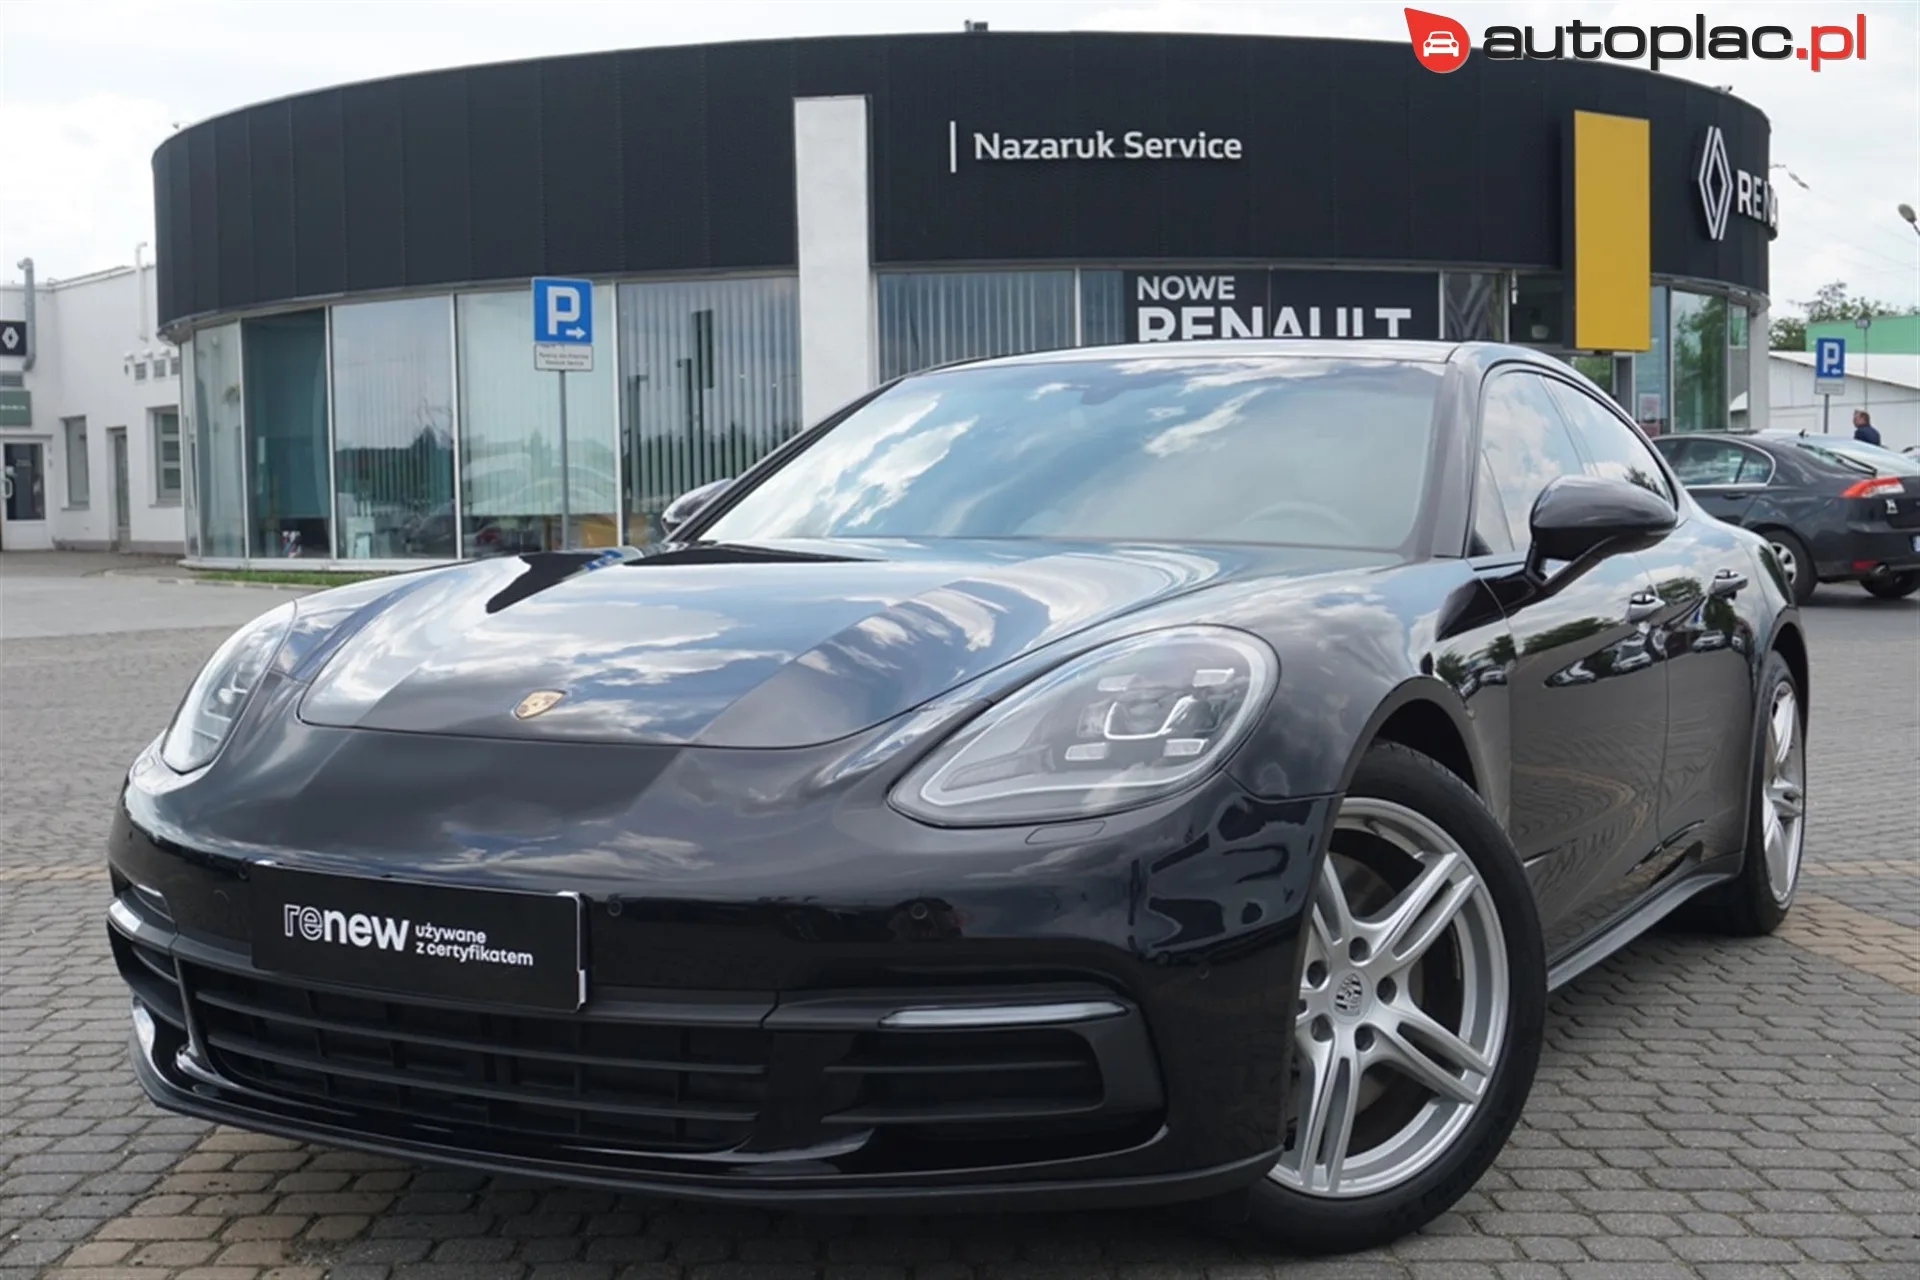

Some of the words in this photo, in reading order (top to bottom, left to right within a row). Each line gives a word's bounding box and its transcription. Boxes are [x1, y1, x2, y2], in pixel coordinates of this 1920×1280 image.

[974, 131, 1115, 160] Nazaruk
[1124, 132, 1243, 160] Service
[1137, 276, 1236, 301] NOWE
[547, 286, 580, 335] P
[1823, 341, 1840, 374] P
[284, 904, 409, 951] renew
[415, 922, 487, 945] używane
[416, 943, 425, 955] z
[427, 943, 534, 966] certyfikatem
